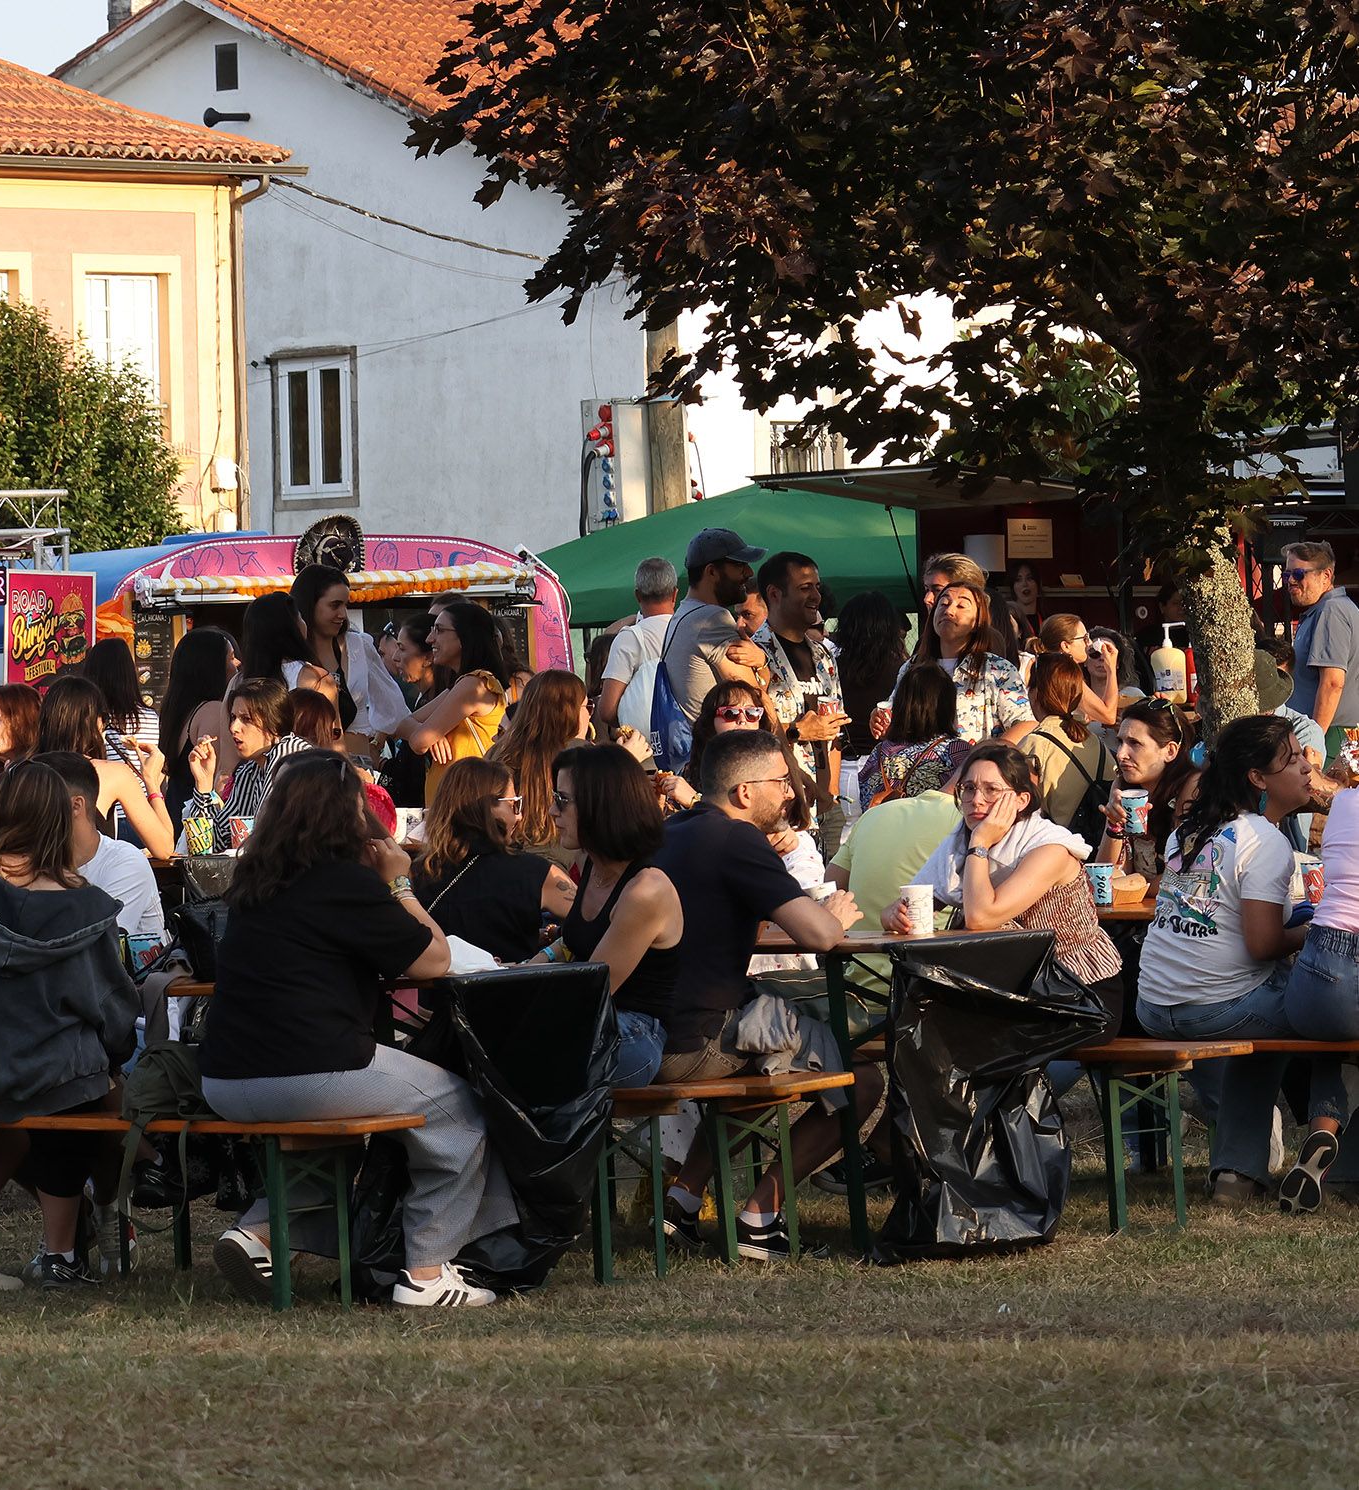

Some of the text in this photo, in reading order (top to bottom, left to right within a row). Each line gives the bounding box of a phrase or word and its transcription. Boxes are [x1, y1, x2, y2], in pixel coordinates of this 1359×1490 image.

[11, 590, 47, 614] ROAD
[11, 614, 59, 661] Burger
[28, 660, 53, 679] FESTIVAL
[1095, 875, 1107, 899] 1906
